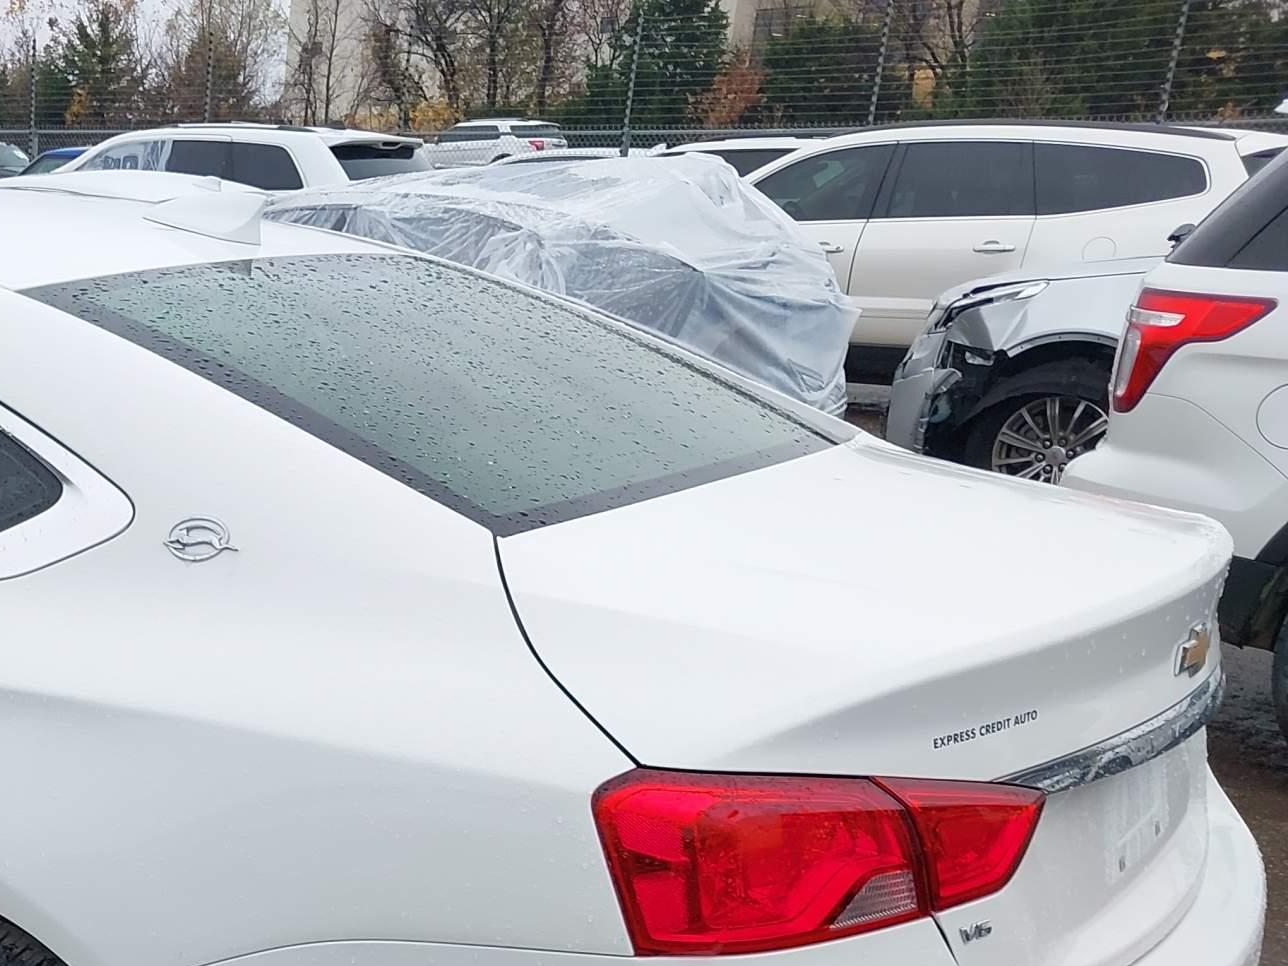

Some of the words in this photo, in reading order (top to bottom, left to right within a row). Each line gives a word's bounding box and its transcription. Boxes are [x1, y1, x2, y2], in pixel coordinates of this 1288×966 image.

[933, 728, 977, 749] EXPRESS
[979, 718, 1011, 737] CREDIT
[1013, 709, 1038, 727] AUTO
[959, 920, 992, 945] V6
